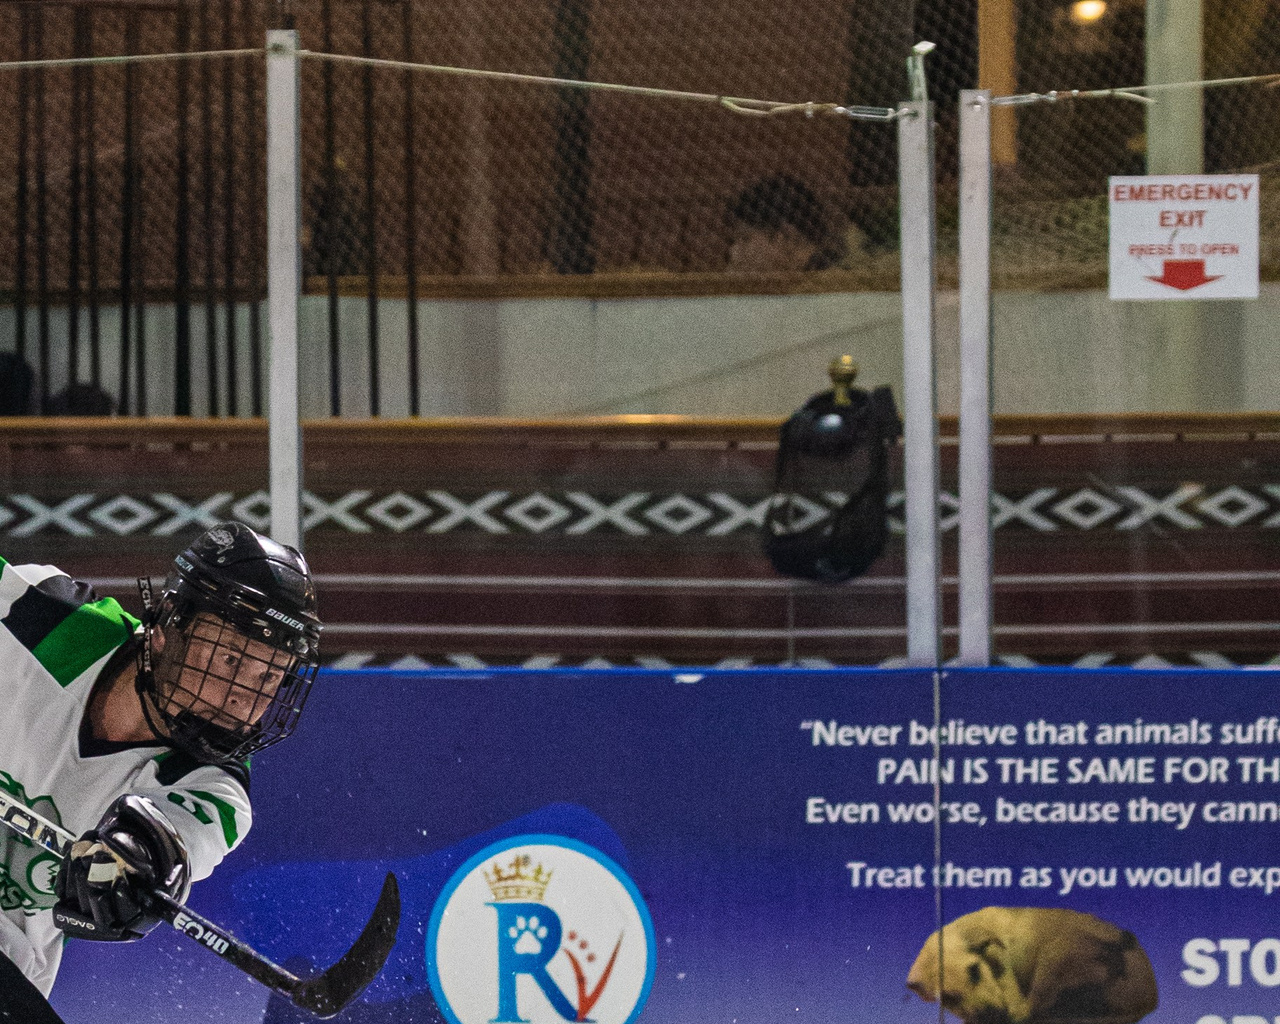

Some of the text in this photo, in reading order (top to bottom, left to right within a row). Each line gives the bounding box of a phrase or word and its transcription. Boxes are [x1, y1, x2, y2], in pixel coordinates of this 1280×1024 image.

[1114, 183, 1253, 201] EMERGENCY
[1158, 210, 1207, 228] EXIT
[1128, 244, 1239, 256] PRESS TO OPEN
[265, 608, 305, 631] BAUER
[909, 719, 1018, 746] believe
[1025, 719, 1088, 745] that
[1095, 718, 1213, 745] animals
[1220, 716, 1280, 745] suff
[877, 758, 955, 784] PAIN
[963, 758, 989, 784] IS
[995, 757, 1060, 784] THE
[1067, 757, 1156, 784] SAME
[1164, 757, 1229, 784] FOR
[806, 797, 880, 824] Even
[995, 797, 1119, 824] because
[1127, 797, 1195, 830] they
[1202, 801, 1280, 824] cann
[846, 862, 926, 888] Treat
[933, 862, 1012, 888] them
[1019, 867, 1052, 888] as
[1059, 867, 1117, 895] you
[1125, 862, 1221, 888] would
